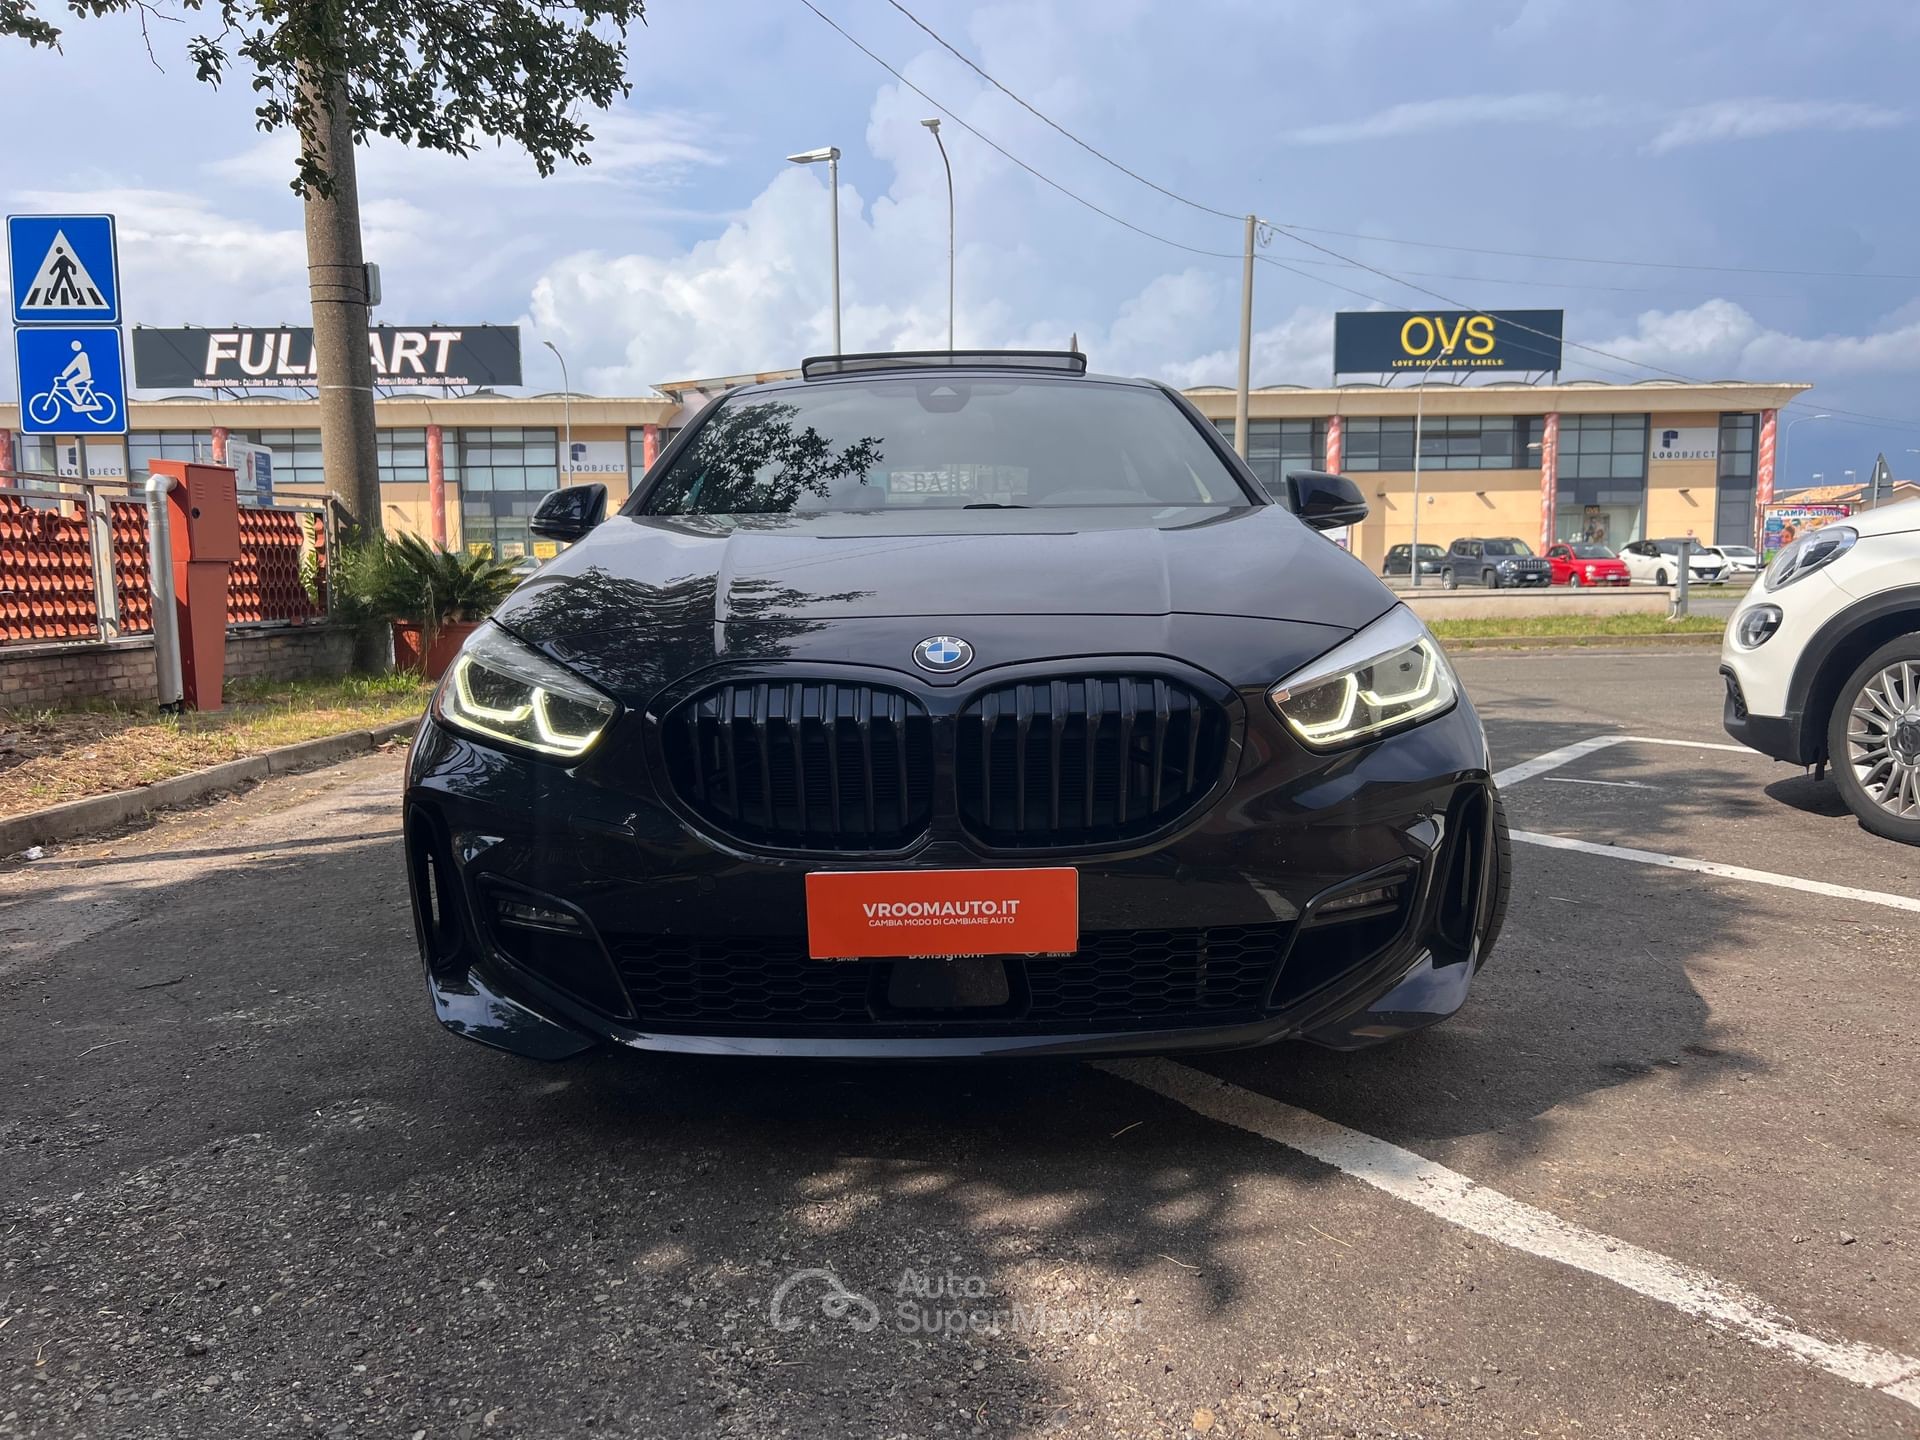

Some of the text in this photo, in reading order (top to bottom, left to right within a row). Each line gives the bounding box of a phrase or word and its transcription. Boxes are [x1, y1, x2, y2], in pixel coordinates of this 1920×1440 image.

[1401, 315, 1495, 355] OVS
[205, 331, 463, 375] FULART
[1392, 359, 1413, 367] LOVE
[1652, 451, 1715, 459] LOGOBJECT
[60, 467, 122, 476] LOBJECT
[562, 464, 625, 472] LOGOBJECT
[920, 636, 967, 648] BMW
[863, 900, 1020, 918] VROOMAUTO.IT
[868, 916, 1015, 928] CAMBIA MODO DI CAMBIARE AUTO
